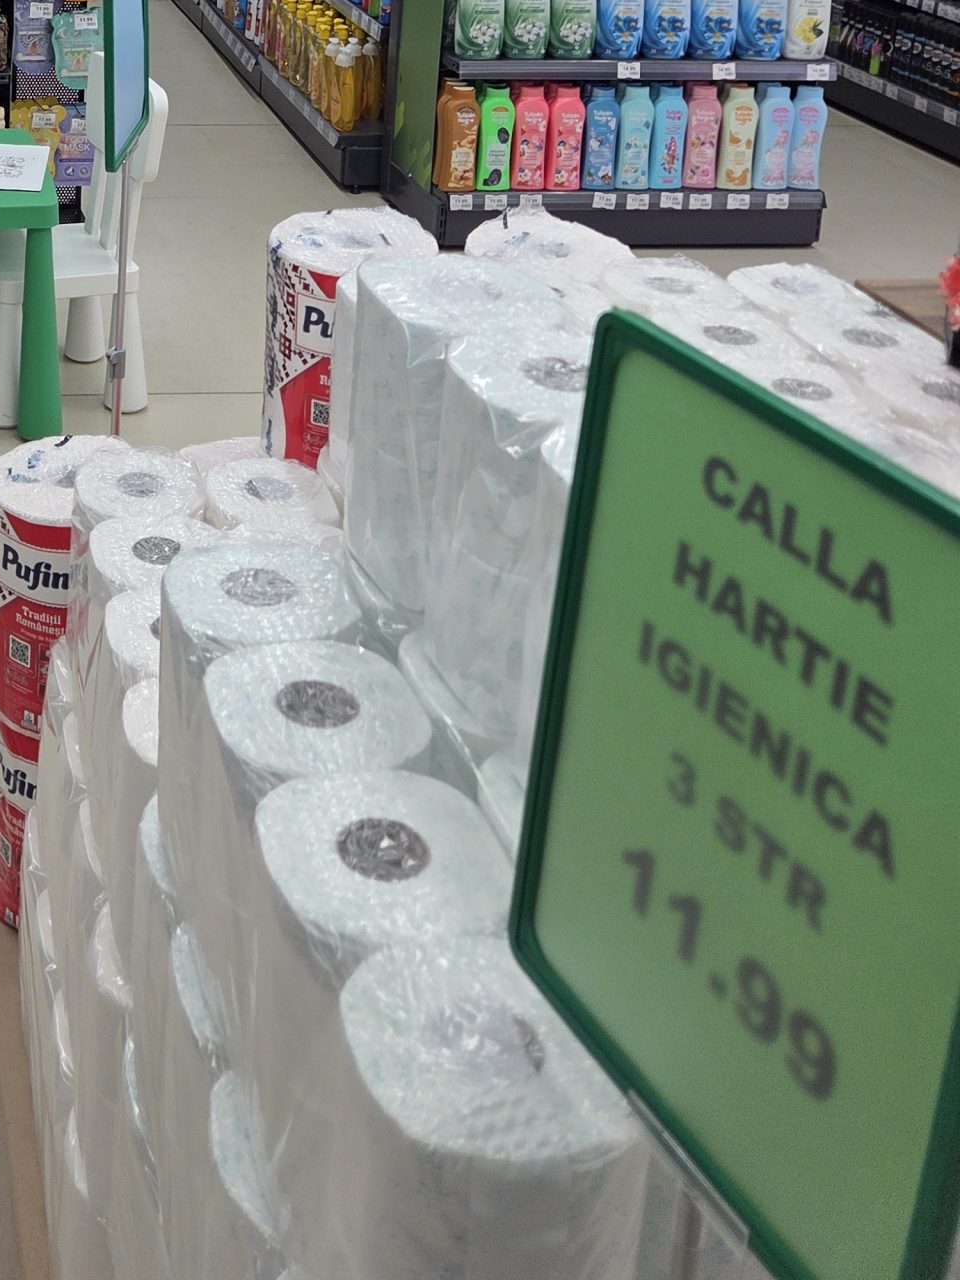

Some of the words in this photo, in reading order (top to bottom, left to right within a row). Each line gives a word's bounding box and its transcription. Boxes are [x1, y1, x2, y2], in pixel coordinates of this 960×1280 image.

[64, 135, 89, 144] FOOT
[64, 143, 90, 152] MASK
[702, 455, 894, 626] CALLA
[673, 538, 895, 747] HARTIE
[638, 617, 897, 881] IGIENICA
[666, 749, 698, 808] 3
[714, 793, 828, 935] STR
[621, 846, 839, 1103] 11.99
